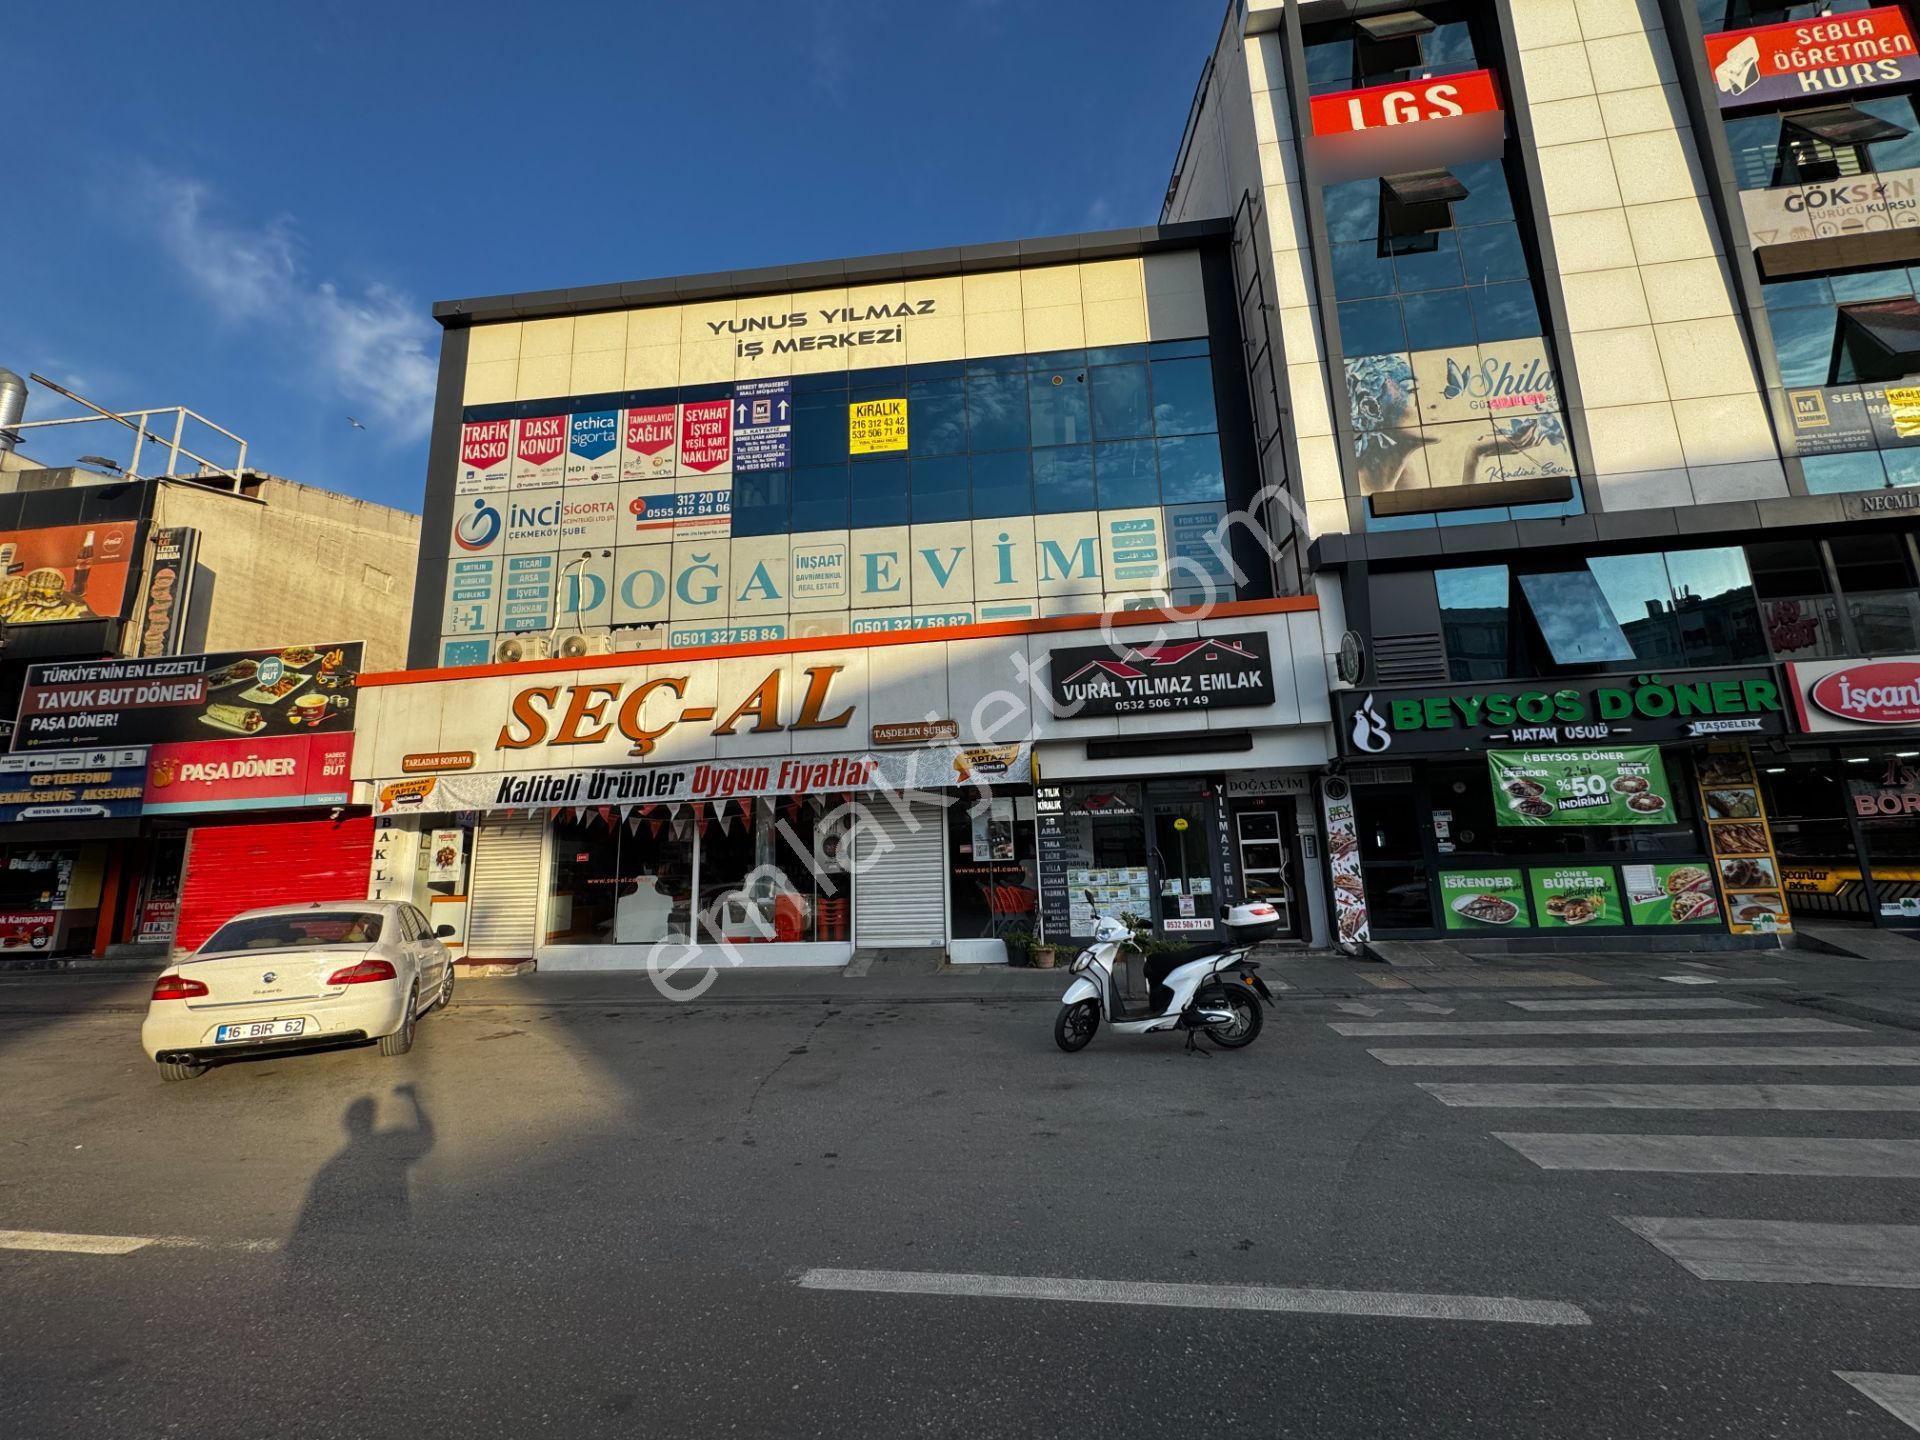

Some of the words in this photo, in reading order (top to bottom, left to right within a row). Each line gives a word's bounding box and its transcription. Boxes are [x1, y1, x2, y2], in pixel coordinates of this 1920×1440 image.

[1795, 18, 1875, 45] SEBLA
[1773, 34, 1912, 70] ÖĞRETMEN
[1797, 58, 1902, 93] KURS
[1784, 178, 1916, 213] GÖKSEN
[1808, 203, 1865, 221] SÜRÜCÜ
[1866, 199, 1917, 214] KURSU
[707, 312, 808, 336] YUNUS
[819, 299, 936, 324] YILMAZ
[737, 339, 763, 361] İŞ
[772, 324, 902, 355] MERKEZİ
[1469, 357, 1556, 398] Shila
[630, 412, 675, 424] TAMAMLAYICI
[685, 406, 728, 422] SEYAHAT
[526, 420, 559, 437] DASK
[574, 416, 615, 430] ethica
[690, 421, 722, 438] İŞYERİ
[852, 420, 867, 429] 216
[868, 419, 882, 429] 312
[884, 418, 893, 427] 43
[895, 417, 905, 426] 42
[465, 422, 508, 442] TRAFİK
[571, 429, 615, 447] sigorta
[628, 424, 673, 444] SAĞLIK
[852, 430, 866, 439] 532
[868, 429, 882, 438] 506
[884, 428, 893, 436] 71
[895, 427, 905, 435] 49
[464, 442, 506, 460] KASKO
[519, 437, 563, 456] KONUT
[685, 437, 705, 449] YEŞİL
[708, 436, 727, 447] KART
[682, 447, 728, 465] NAKLİYAT
[1485, 466, 1536, 482] Kendini
[677, 494, 695, 505] 312
[699, 493, 713, 503] 20
[717, 491, 731, 502] 07
[1863, 489, 1916, 511] NECMİ
[509, 500, 561, 528] İNCİ
[563, 500, 615, 516] SİGORTA
[647, 507, 674, 518] 0555
[676, 506, 695, 515] 412
[698, 505, 712, 514] 94
[716, 503, 730, 512] 06
[508, 527, 558, 540] ÇEKMEKÖY
[561, 526, 586, 537] ŞUBE
[518, 559, 542, 569] TİCARİ
[795, 553, 843, 571] İNŞAAT
[519, 574, 539, 582] ARSA
[563, 552, 783, 614] DOĞA
[859, 532, 1101, 594] EVİM
[798, 584, 814, 592] REAL
[815, 581, 840, 591] ESTATE
[516, 618, 535, 628] DEPO
[854, 618, 890, 635] 0501
[893, 616, 923, 632] 327
[926, 615, 945, 629] 58
[948, 614, 967, 626] 87
[673, 632, 706, 646] 0501
[710, 630, 734, 644] 327
[740, 629, 757, 642] 58
[760, 627, 778, 640] 86
[42, 663, 124, 683] TÜRKİYE'NİN
[125, 665, 144, 677] EN
[146, 656, 207, 677] LEZZETLİ
[262, 672, 278, 681] BUT
[1062, 681, 1121, 701] VURAL
[1126, 675, 1193, 697] YILMAZ
[1199, 669, 1263, 692] EMLAK
[37, 689, 97, 709] TAVUK
[97, 687, 134, 706] BUT
[136, 679, 202, 703] DÖNERİ
[1390, 689, 1586, 731] BEYSOS
[1597, 674, 1783, 720] DÖNER
[495, 664, 857, 757] SEÇ-AL
[1115, 699, 1144, 711] 0532
[1149, 698, 1170, 709] 506
[1175, 696, 1188, 707] 71
[1193, 695, 1209, 706] 49
[30, 714, 66, 732] PAŞA
[68, 712, 120, 729] DÖNER!
[1699, 719, 1757, 733] TAŞDELEN
[874, 727, 921, 740] TAŞDELEN
[1512, 727, 1558, 744] HATAY
[1564, 722, 1609, 740] USULÜ
[404, 756, 439, 768] TARLADAN
[964, 752, 1011, 764] TAPTAZE
[1531, 752, 1579, 763] BEYSOS
[1582, 750, 1624, 762] DÖNER
[180, 762, 229, 785] PAŞA
[231, 755, 296, 779] DÖNER
[323, 765, 346, 776] BUT
[1617, 763, 1650, 775] BEYTİ
[495, 773, 583, 804] Kaliteli
[590, 769, 685, 799] Ürünler
[691, 765, 770, 799] Uygun
[776, 756, 879, 801] Fiyatlar
[1229, 778, 1268, 792] DOĞA
[1556, 774, 1607, 797] %50
[390, 784, 428, 796] TAPTAZE
[1037, 799, 1063, 811] KİRALIK
[1328, 803, 1350, 815] BEY
[1558, 792, 1610, 811] İNDİRİMLİ
[1041, 826, 1061, 835] ARSA
[1044, 840, 1060, 848] TARLA
[1444, 876, 1513, 889] İSKENDER
[1542, 876, 1605, 889] BURGER
[1555, 870, 1589, 878] DÖNER
[8, 914, 54, 924] Kampanya
[227, 1026, 241, 1039] 16
[250, 1023, 274, 1037] BIR
[284, 1019, 302, 1033] 62
